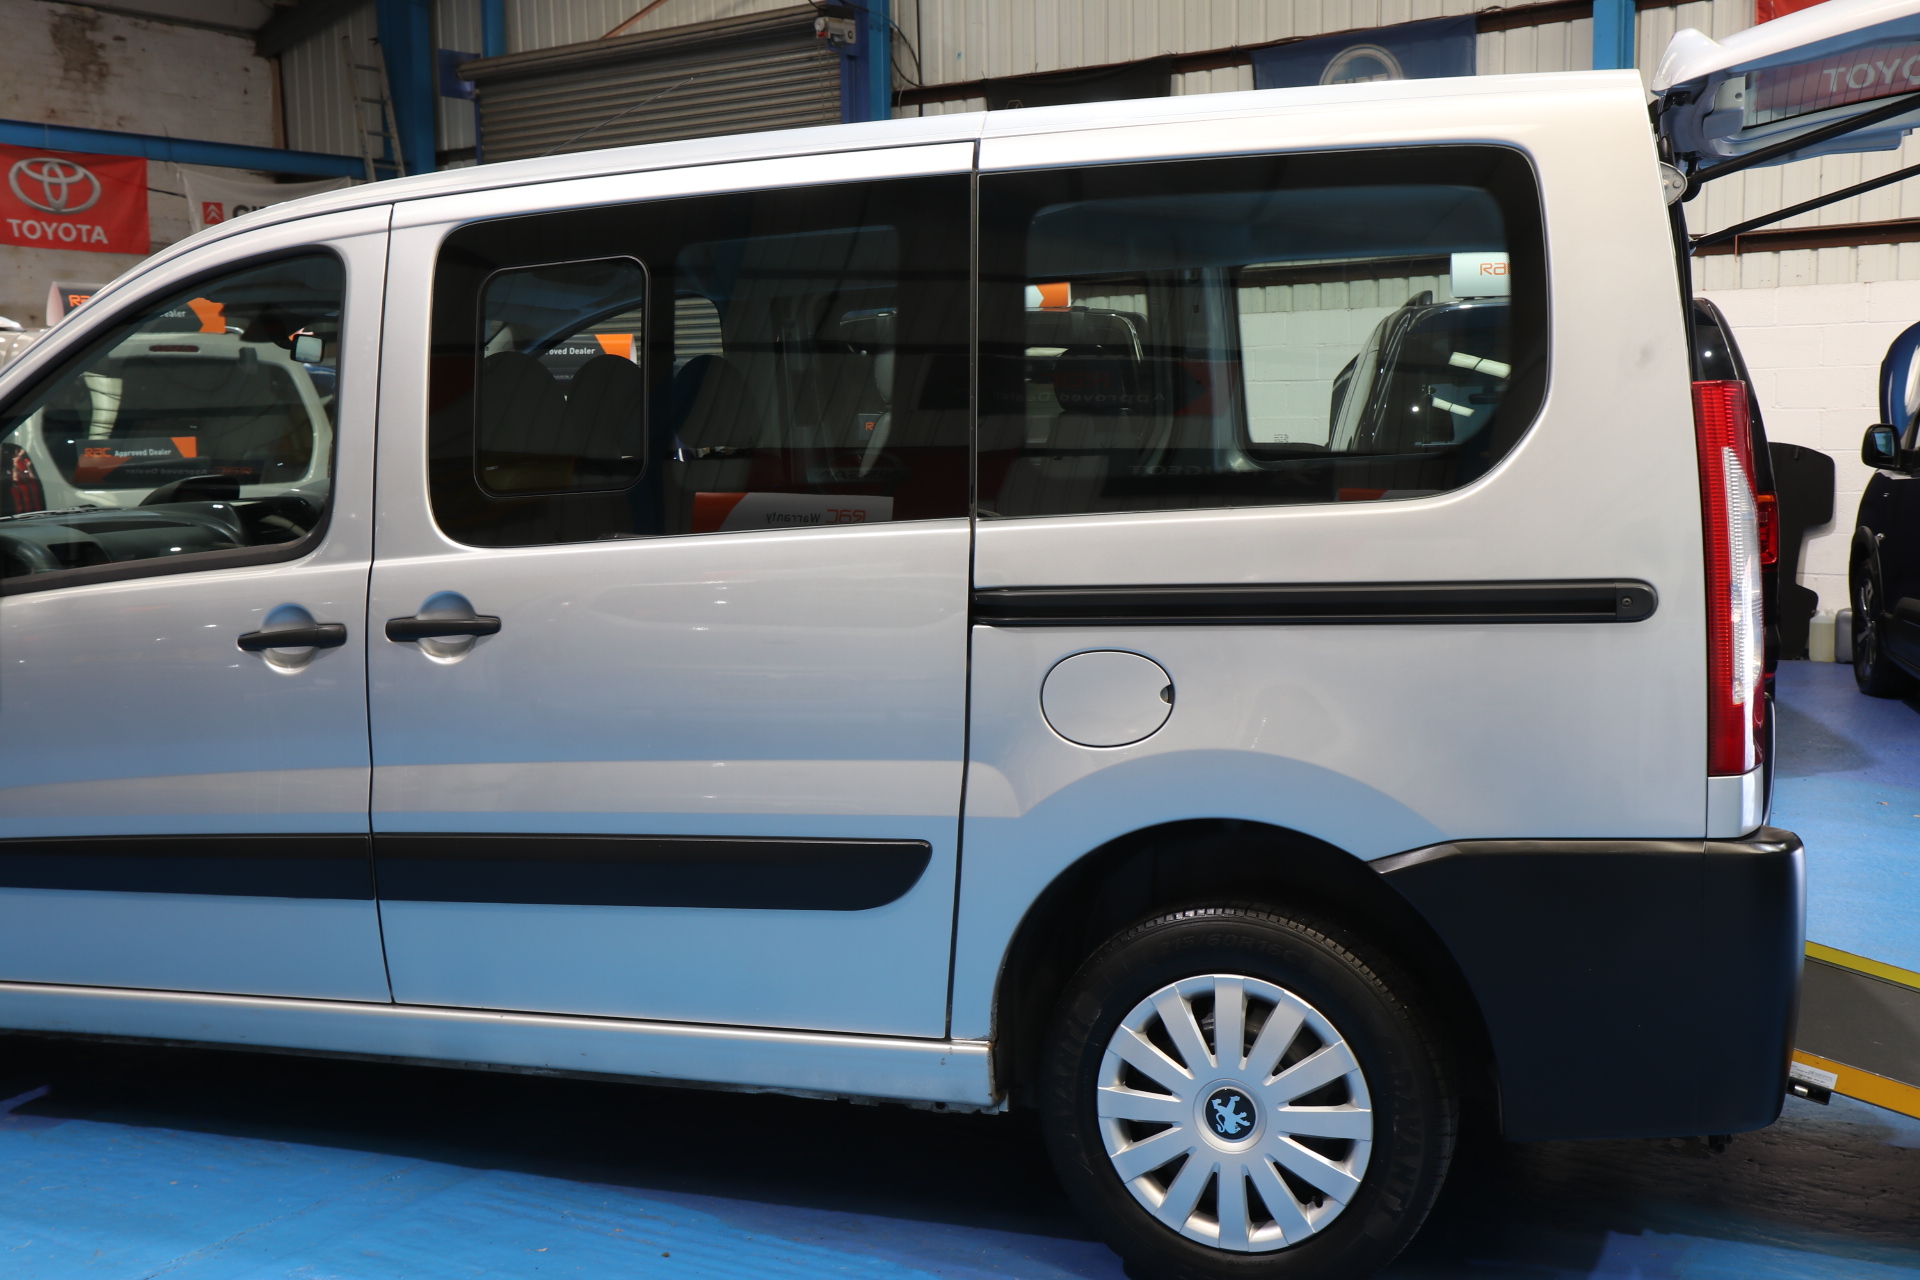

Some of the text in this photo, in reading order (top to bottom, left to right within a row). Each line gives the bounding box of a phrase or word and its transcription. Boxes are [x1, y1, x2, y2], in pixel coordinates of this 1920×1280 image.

[6, 218, 109, 244] TOYOTA
[1480, 263, 1511, 275] RA
[159, 309, 187, 318] ealer
[569, 347, 596, 355] Dealer
[114, 449, 147, 458] Approved
[148, 448, 172, 456] Dealer
